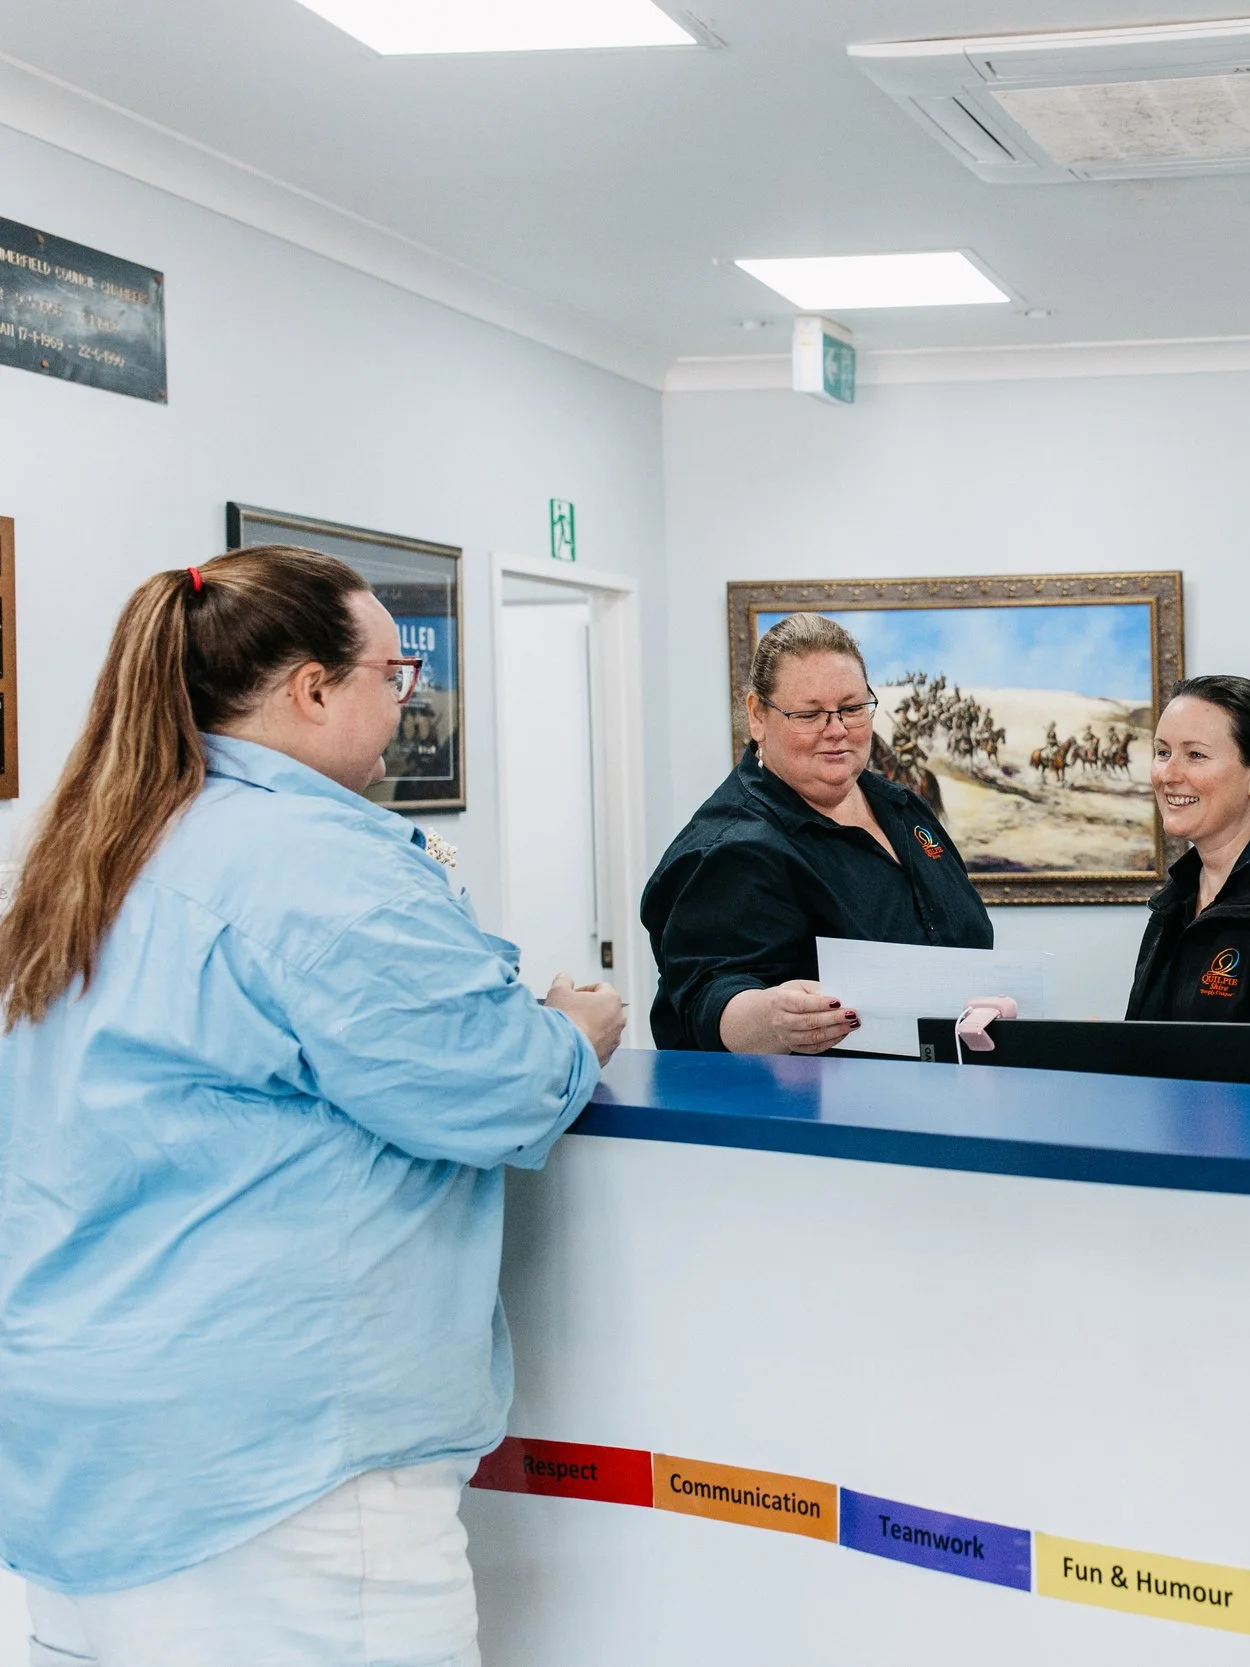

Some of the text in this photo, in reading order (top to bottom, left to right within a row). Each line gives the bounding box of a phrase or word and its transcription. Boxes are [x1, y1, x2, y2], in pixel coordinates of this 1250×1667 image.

[1202, 974, 1238, 986] QUILPIE
[523, 1455, 598, 1483] Respect
[669, 1472, 821, 1519] Communication
[877, 1514, 985, 1560] Teamwork
[1063, 1556, 1233, 1607] Fun & Humour
